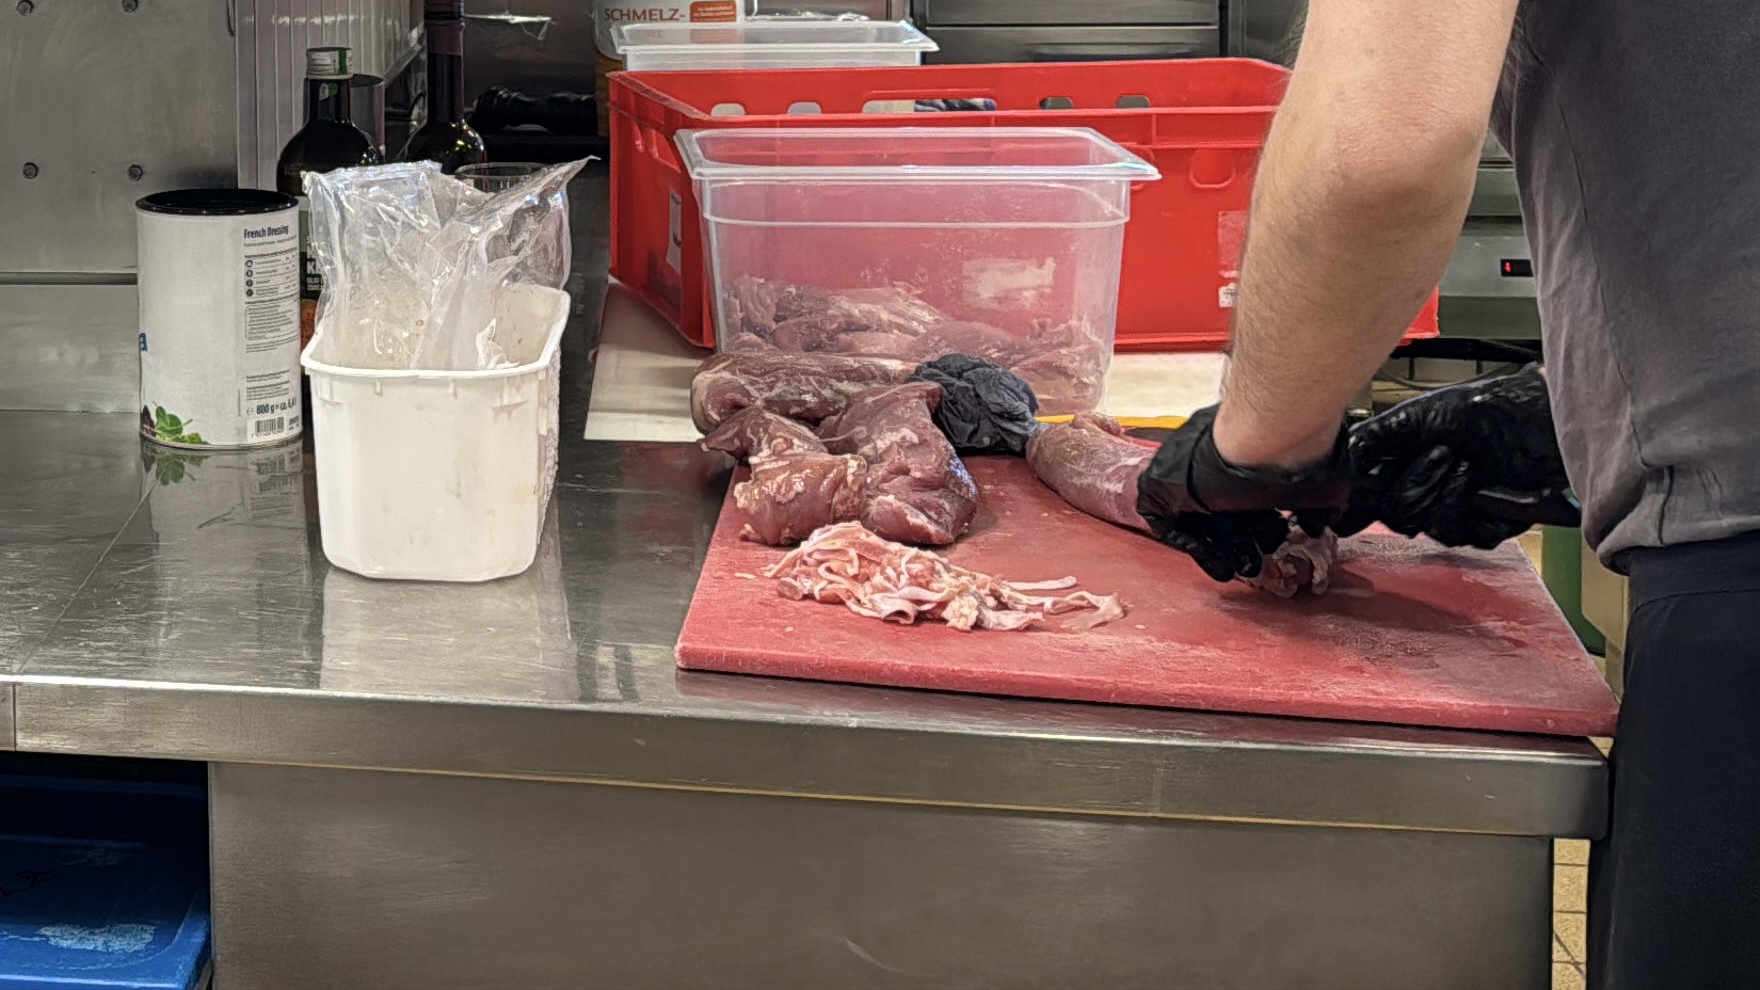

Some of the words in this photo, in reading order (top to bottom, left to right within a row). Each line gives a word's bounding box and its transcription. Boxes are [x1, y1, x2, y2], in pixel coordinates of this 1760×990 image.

[604, 8, 686, 21] SCHMELZ-
[243, 227, 267, 239] French
[267, 225, 289, 236] Dressing
